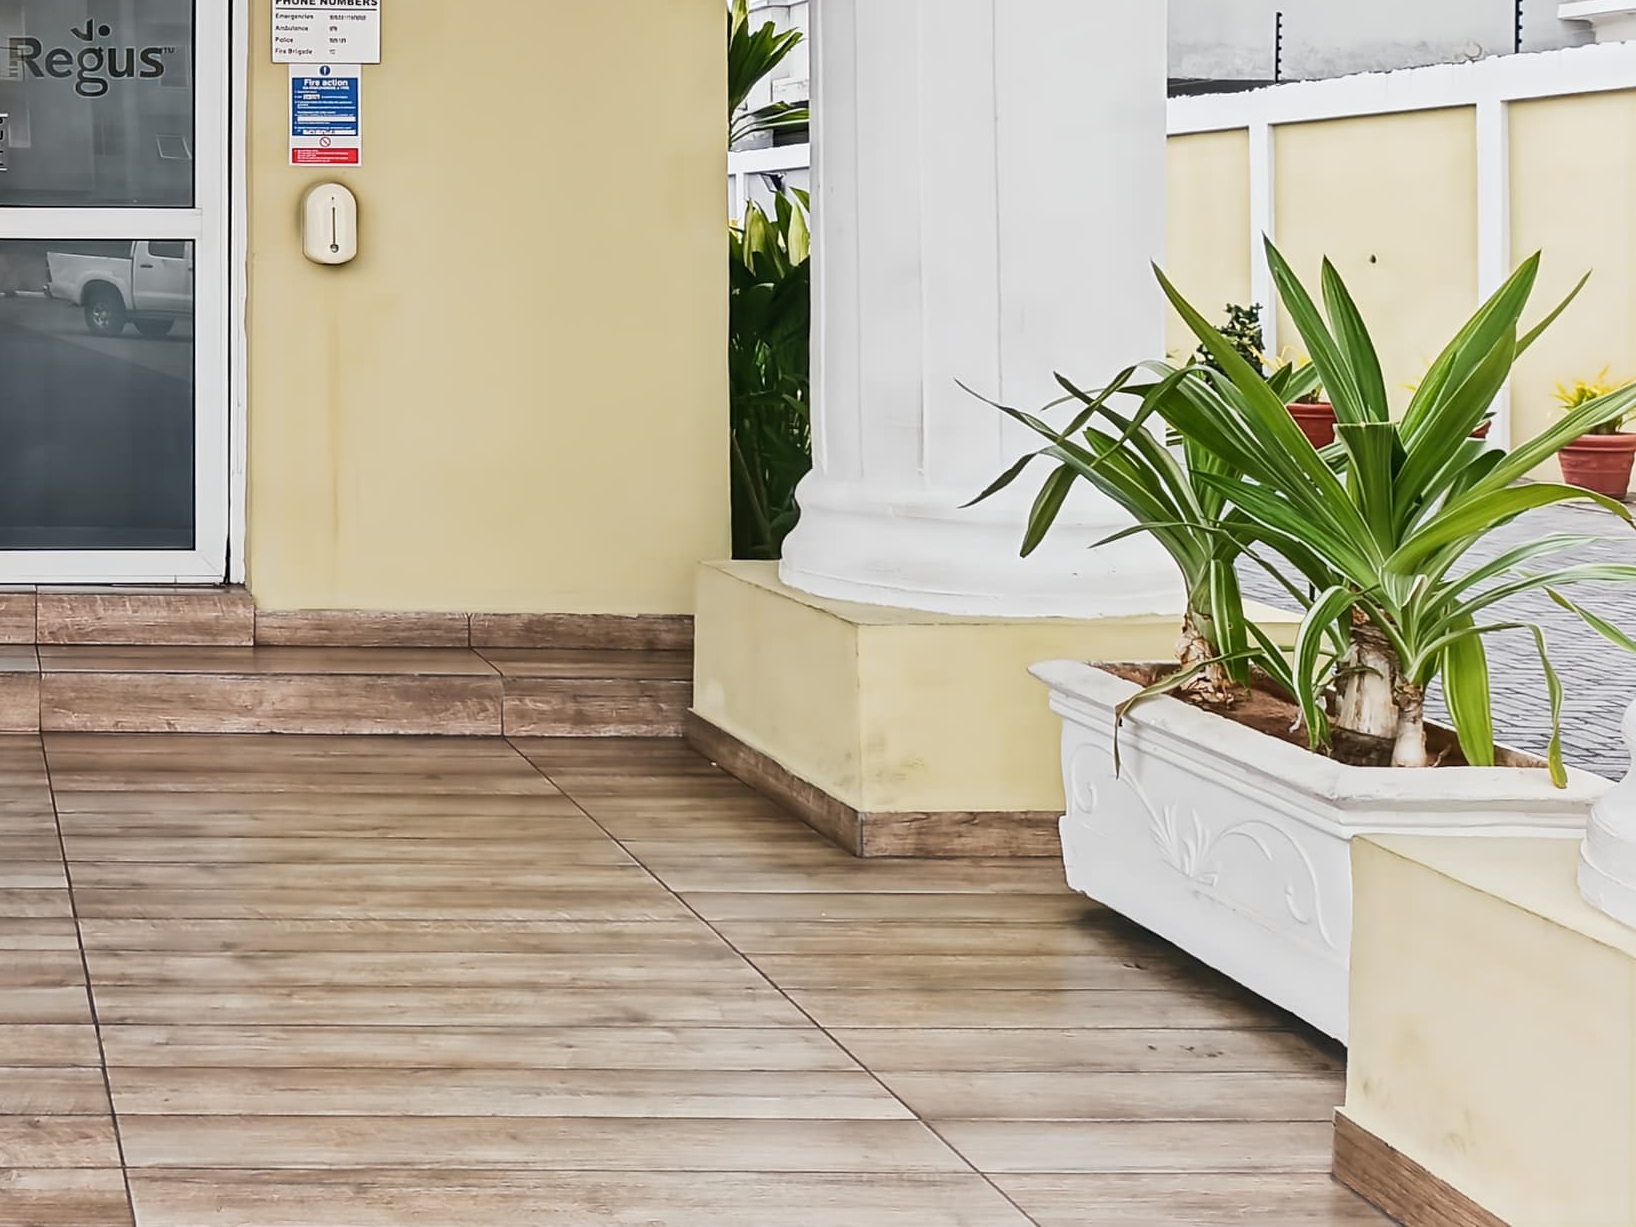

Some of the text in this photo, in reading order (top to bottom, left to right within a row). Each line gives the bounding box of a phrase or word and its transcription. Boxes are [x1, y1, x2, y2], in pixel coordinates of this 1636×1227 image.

[275, 13, 314, 21] Emergencies
[275, 36, 294, 44] Police
[9, 37, 165, 97] Regus
[304, 78, 349, 86] Fire action
